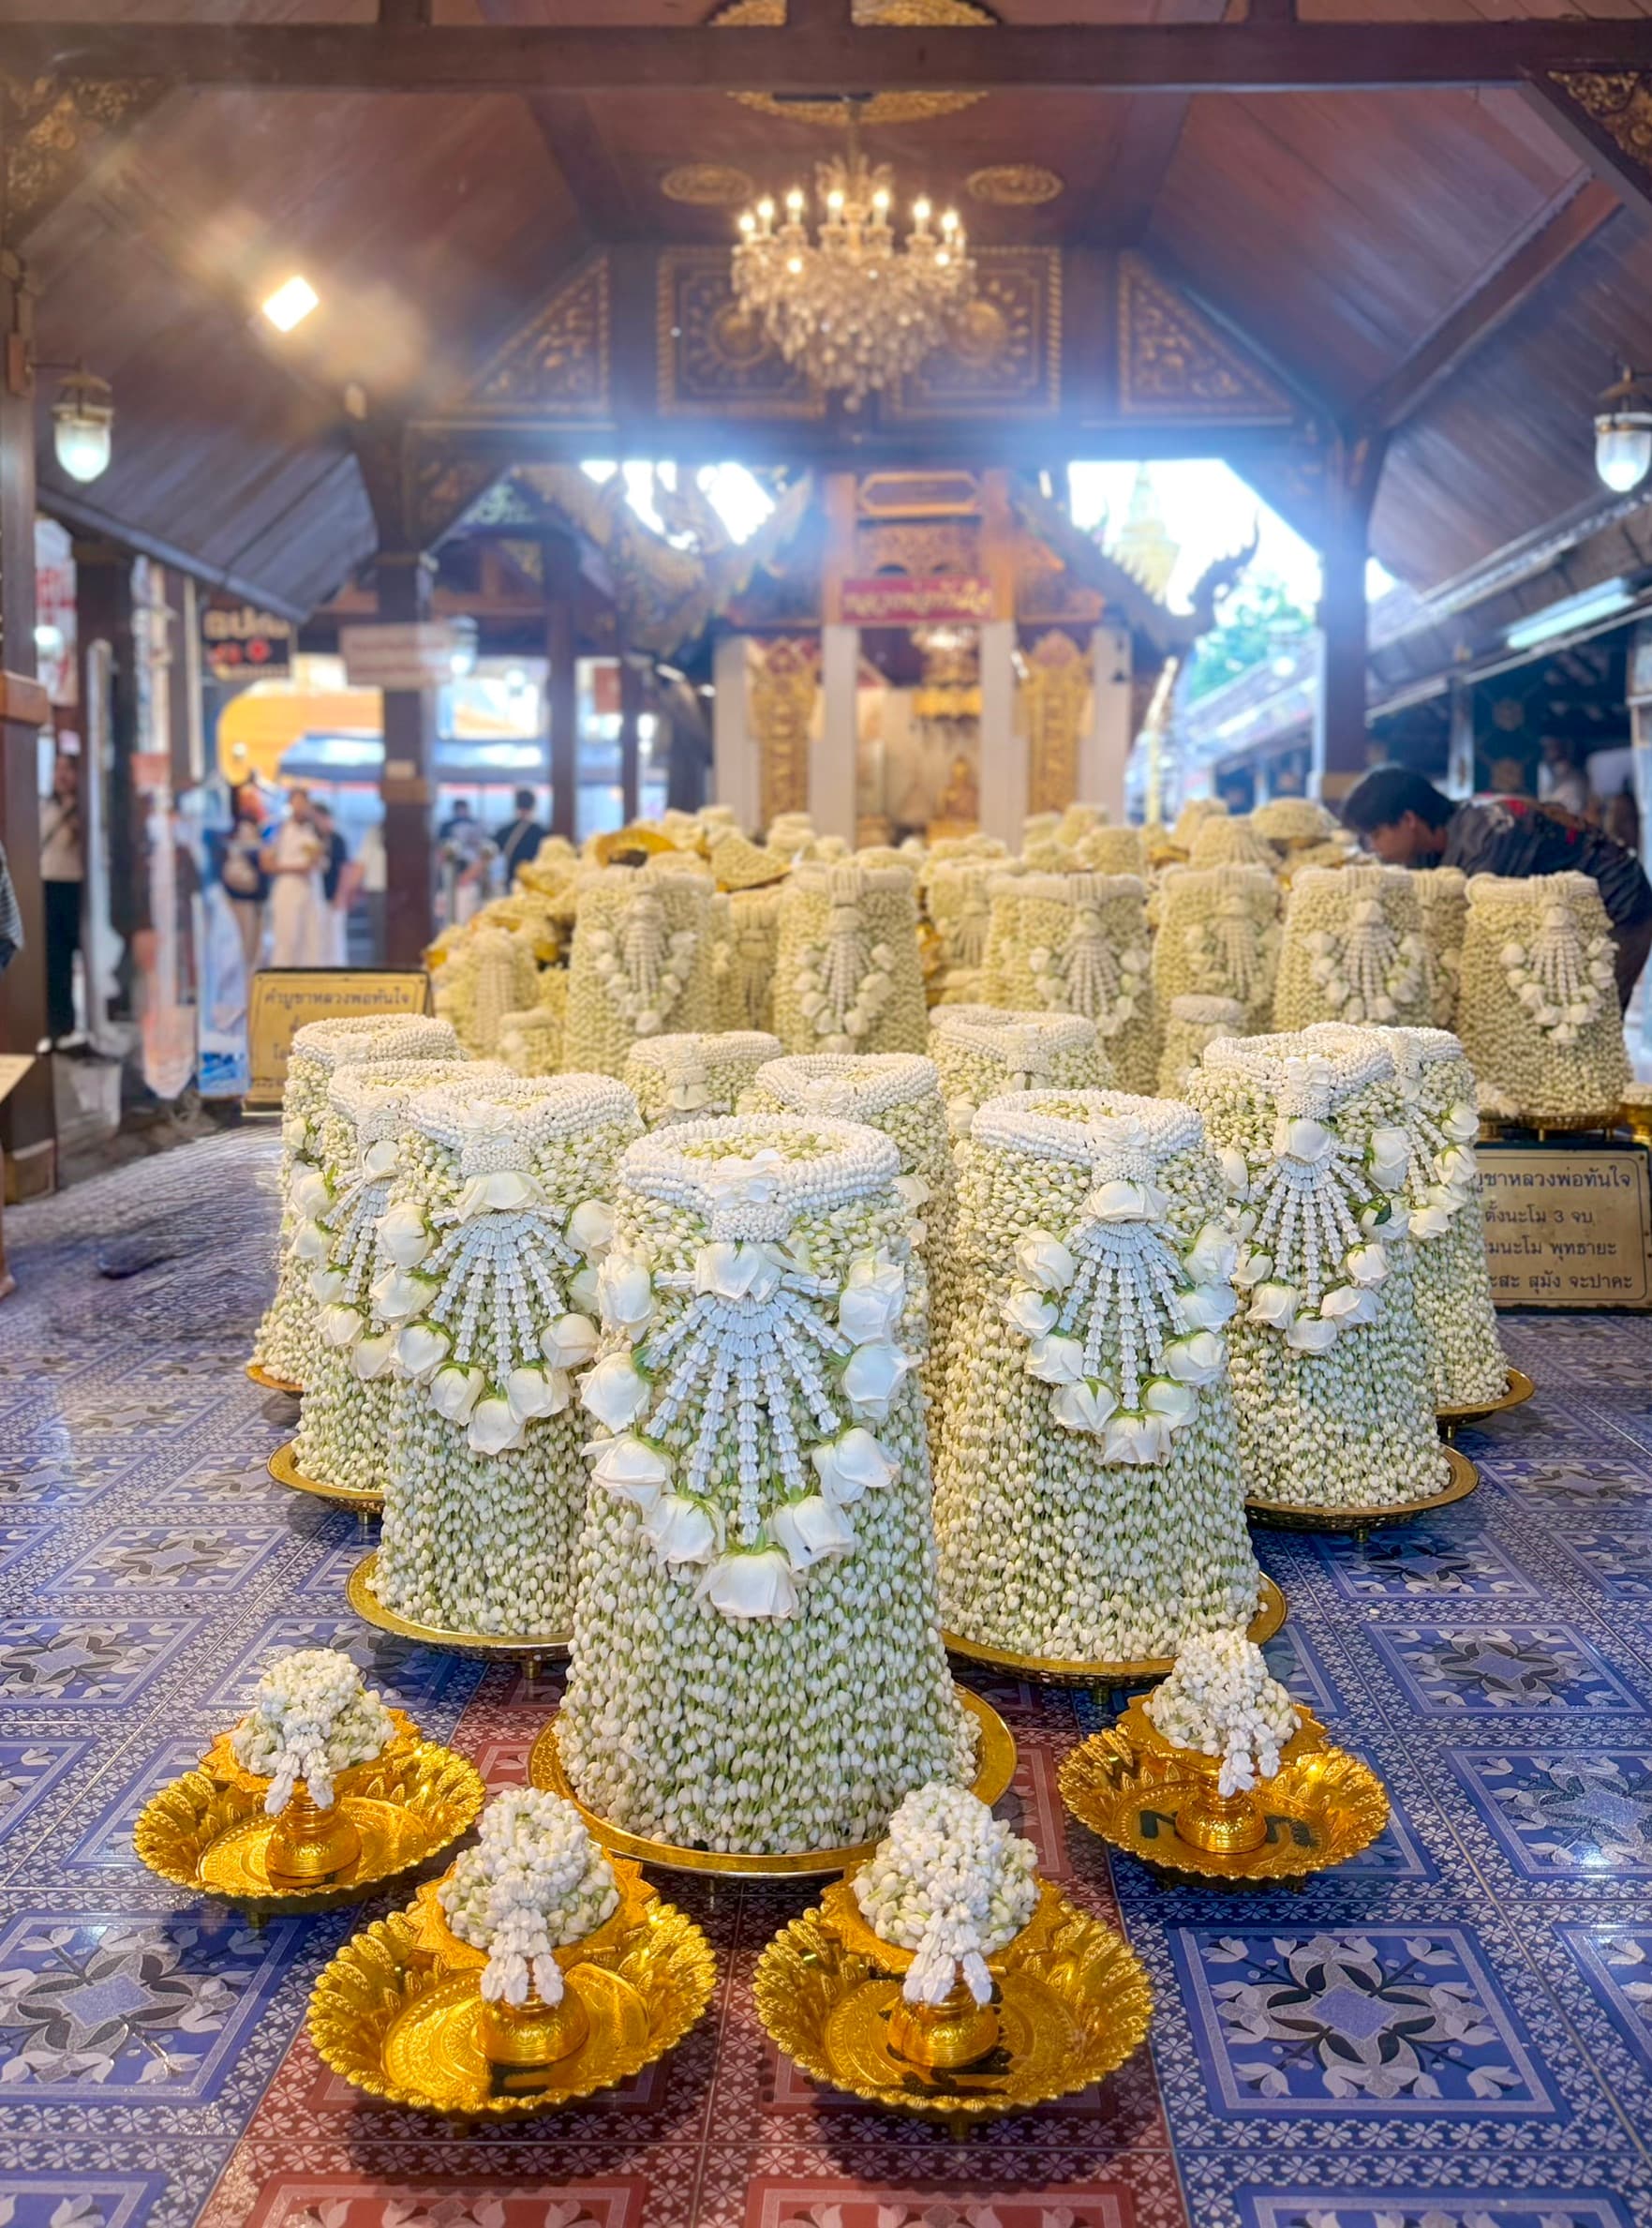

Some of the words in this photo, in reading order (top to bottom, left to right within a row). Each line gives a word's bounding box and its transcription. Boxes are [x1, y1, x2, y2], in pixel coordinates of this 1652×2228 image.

[1554, 1210, 1564, 1222] 3
[1570, 1211, 1593, 1222] จบ
[1549, 1242, 1617, 1262] พุทธายะ
